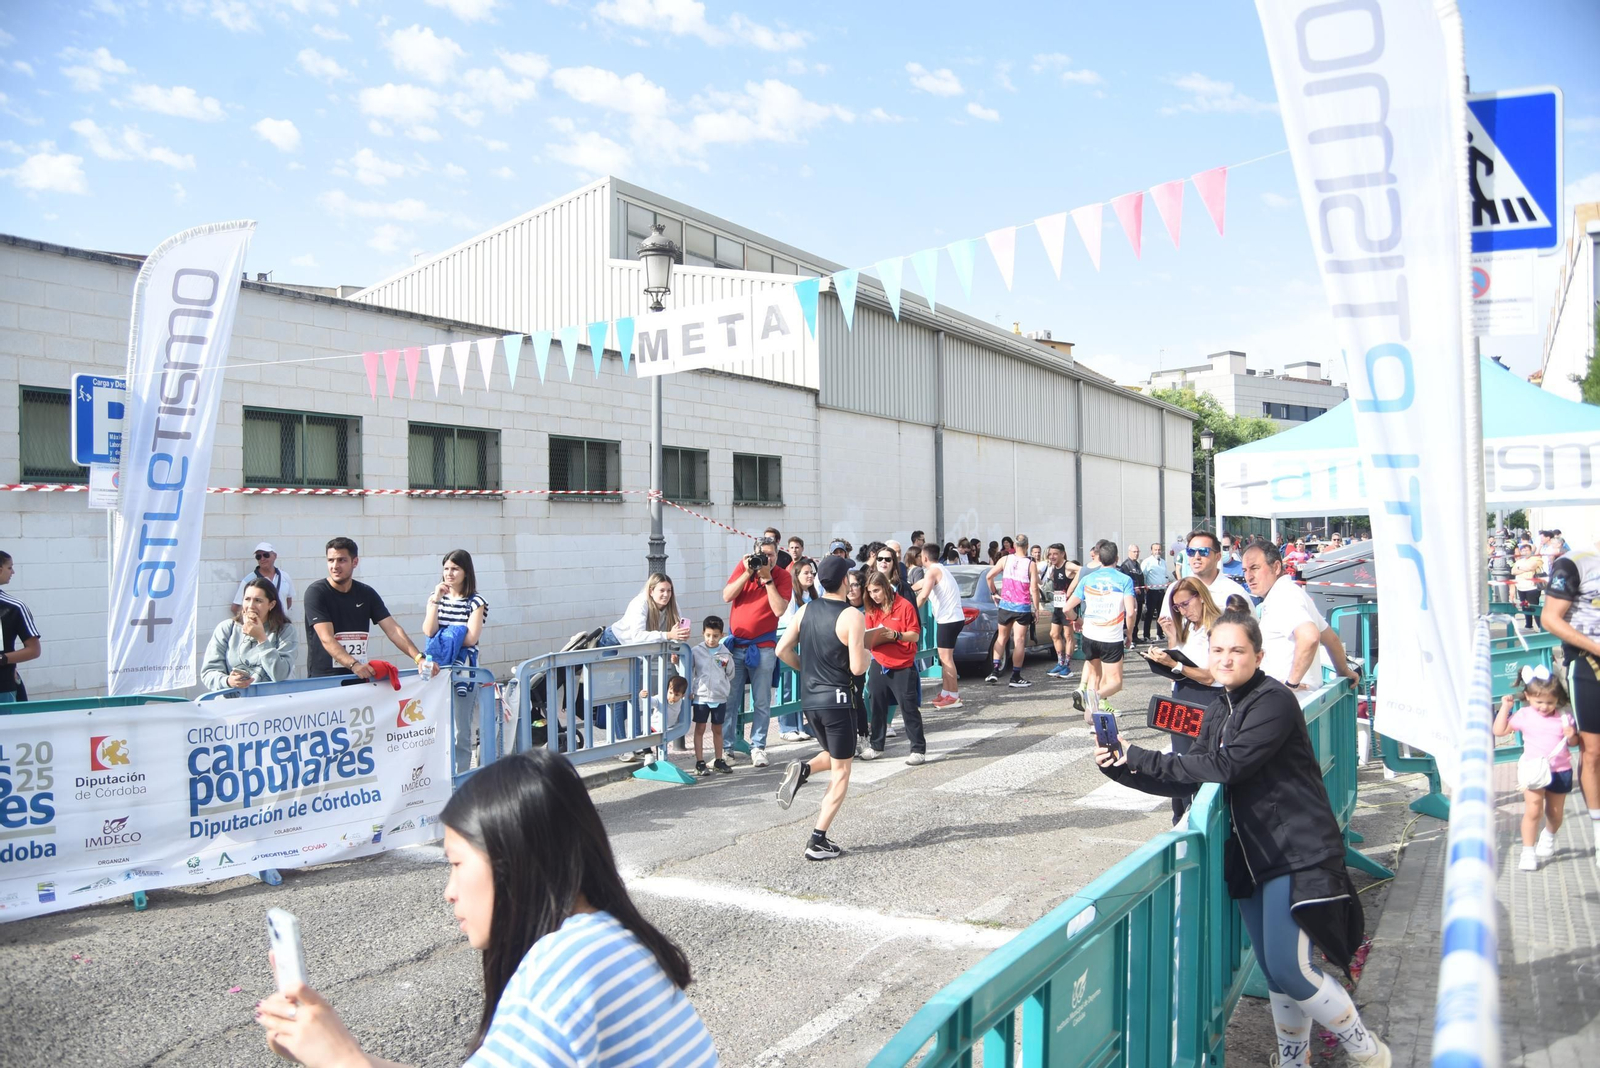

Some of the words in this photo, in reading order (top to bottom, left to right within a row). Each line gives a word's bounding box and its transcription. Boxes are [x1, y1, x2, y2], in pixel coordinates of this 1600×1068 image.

[638, 304, 791, 364] META
[92, 378, 110, 389] Carga
[110, 381, 114, 389] y
[93, 386, 125, 455] P
[350, 705, 375, 728] 20
[187, 721, 260, 745] CIRCUITO
[264, 709, 347, 735] PROVINCIAL
[386, 726, 436, 742] Diputación
[351, 727, 376, 749] 25
[15, 741, 54, 767] 20
[187, 727, 350, 777] carreras
[387, 743, 399, 753] de
[16, 766, 54, 793] 25
[75, 772, 146, 788] Diputación
[189, 746, 376, 818] populares
[401, 777, 431, 793] IMDECO
[75, 789, 91, 801] de
[95, 784, 147, 799] Córdoba
[189, 805, 283, 839] Diputación
[288, 801, 307, 818] de
[311, 788, 382, 812] Córdoba
[274, 826, 302, 835] COLABORAN
[85, 832, 142, 849] IMDECO
[260, 848, 299, 859] DECATHLON
[301, 842, 328, 852] COVAP
[97, 857, 130, 866] ORGANIZAN
